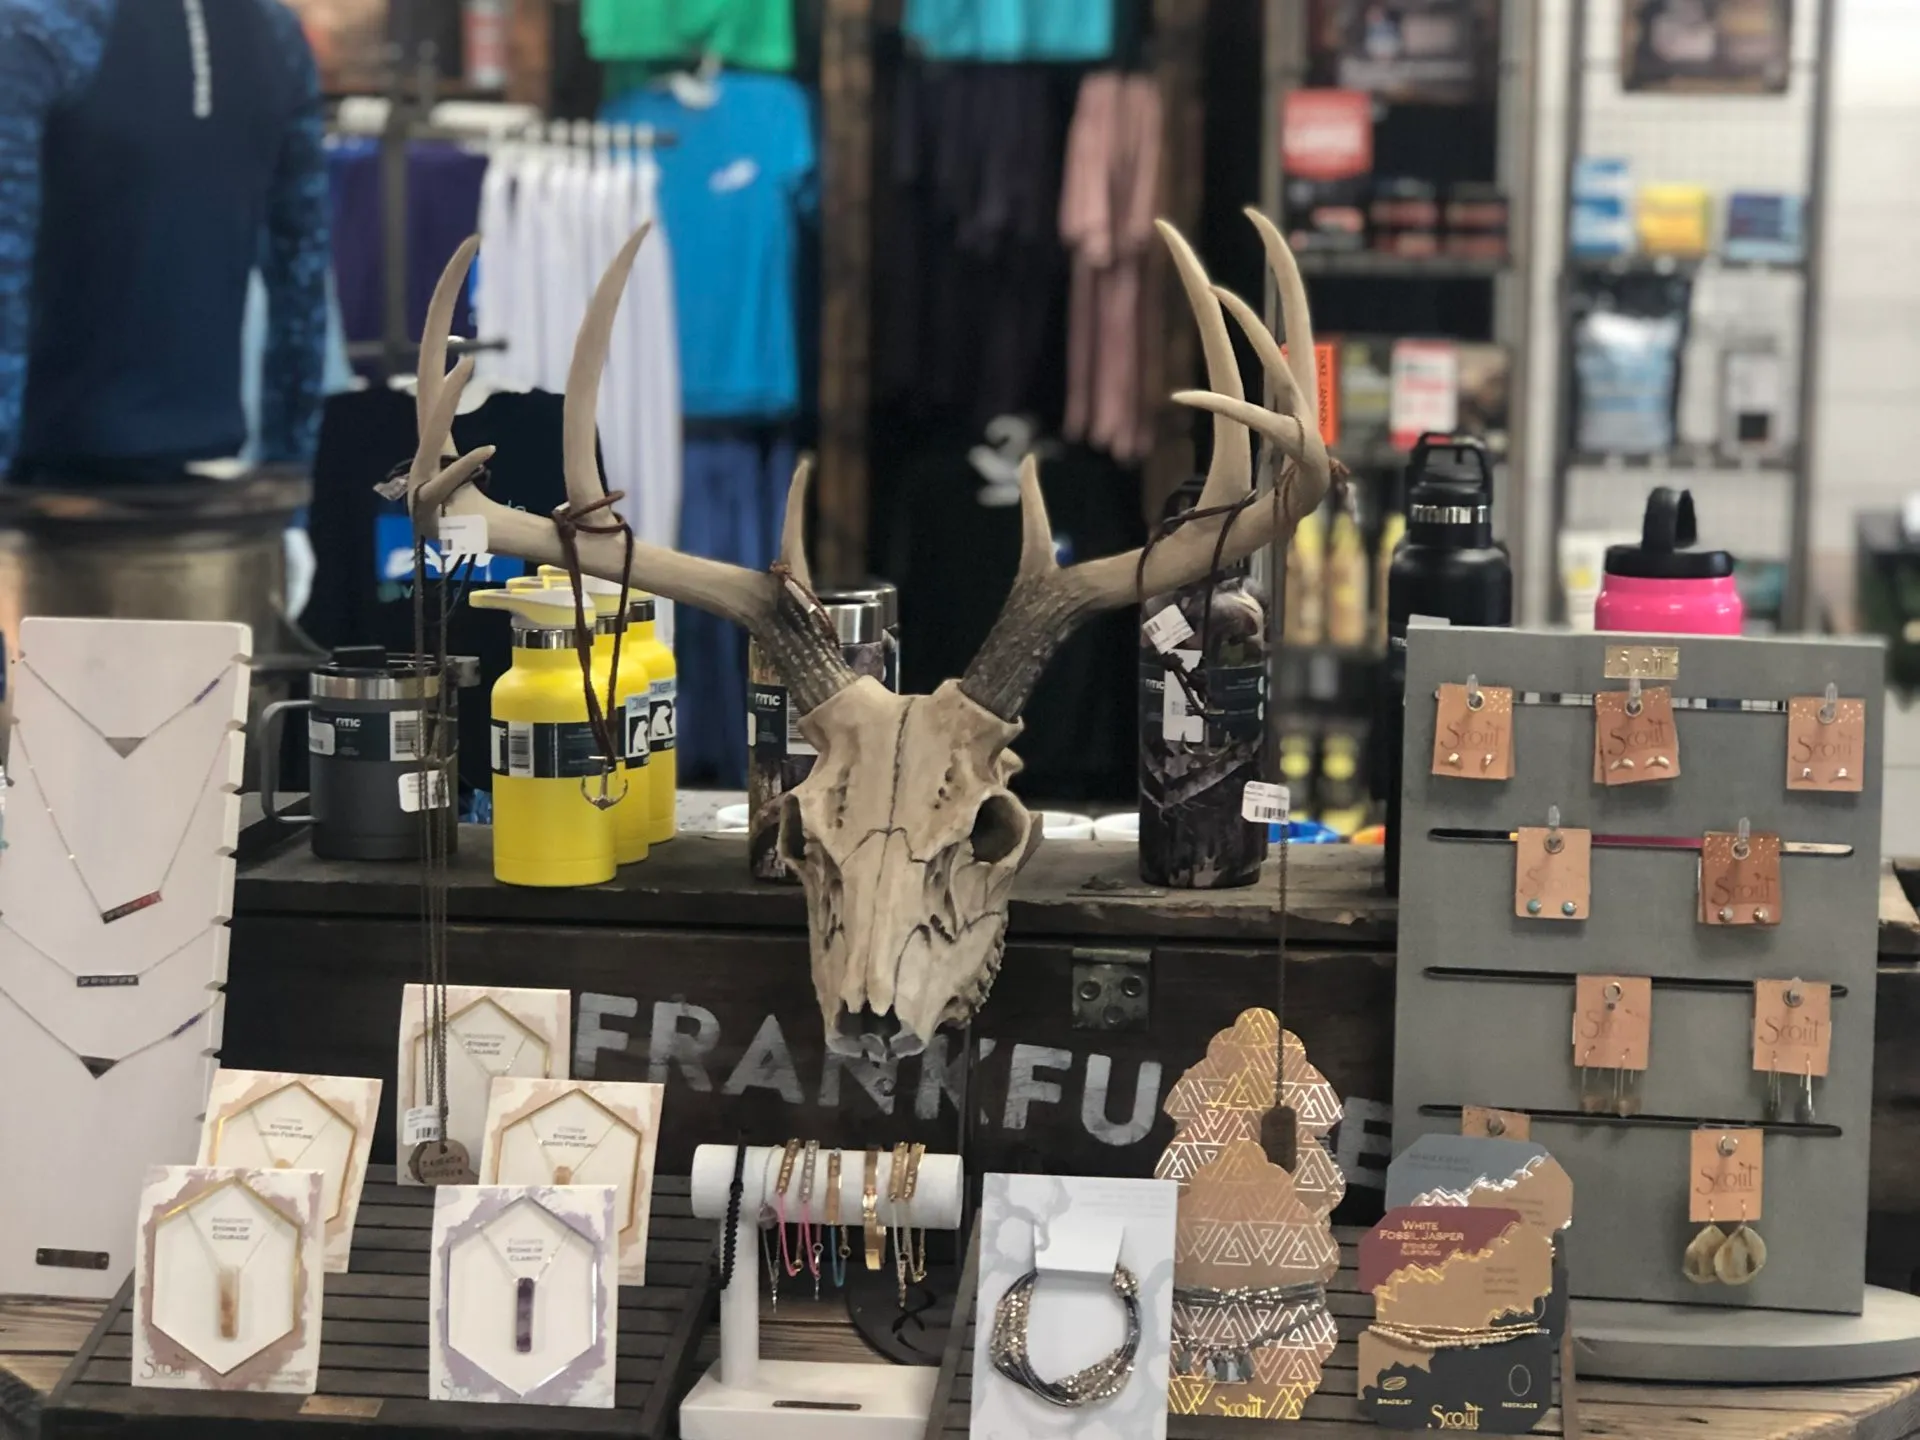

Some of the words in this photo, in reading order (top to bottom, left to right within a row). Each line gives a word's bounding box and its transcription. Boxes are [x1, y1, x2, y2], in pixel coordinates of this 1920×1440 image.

[1402, 1220, 1439, 1231] WHITE
[1379, 1230, 1420, 1241] FOSSIL
[1421, 1231, 1464, 1241] JASPER
[1427, 1401, 1484, 1430] Scout
